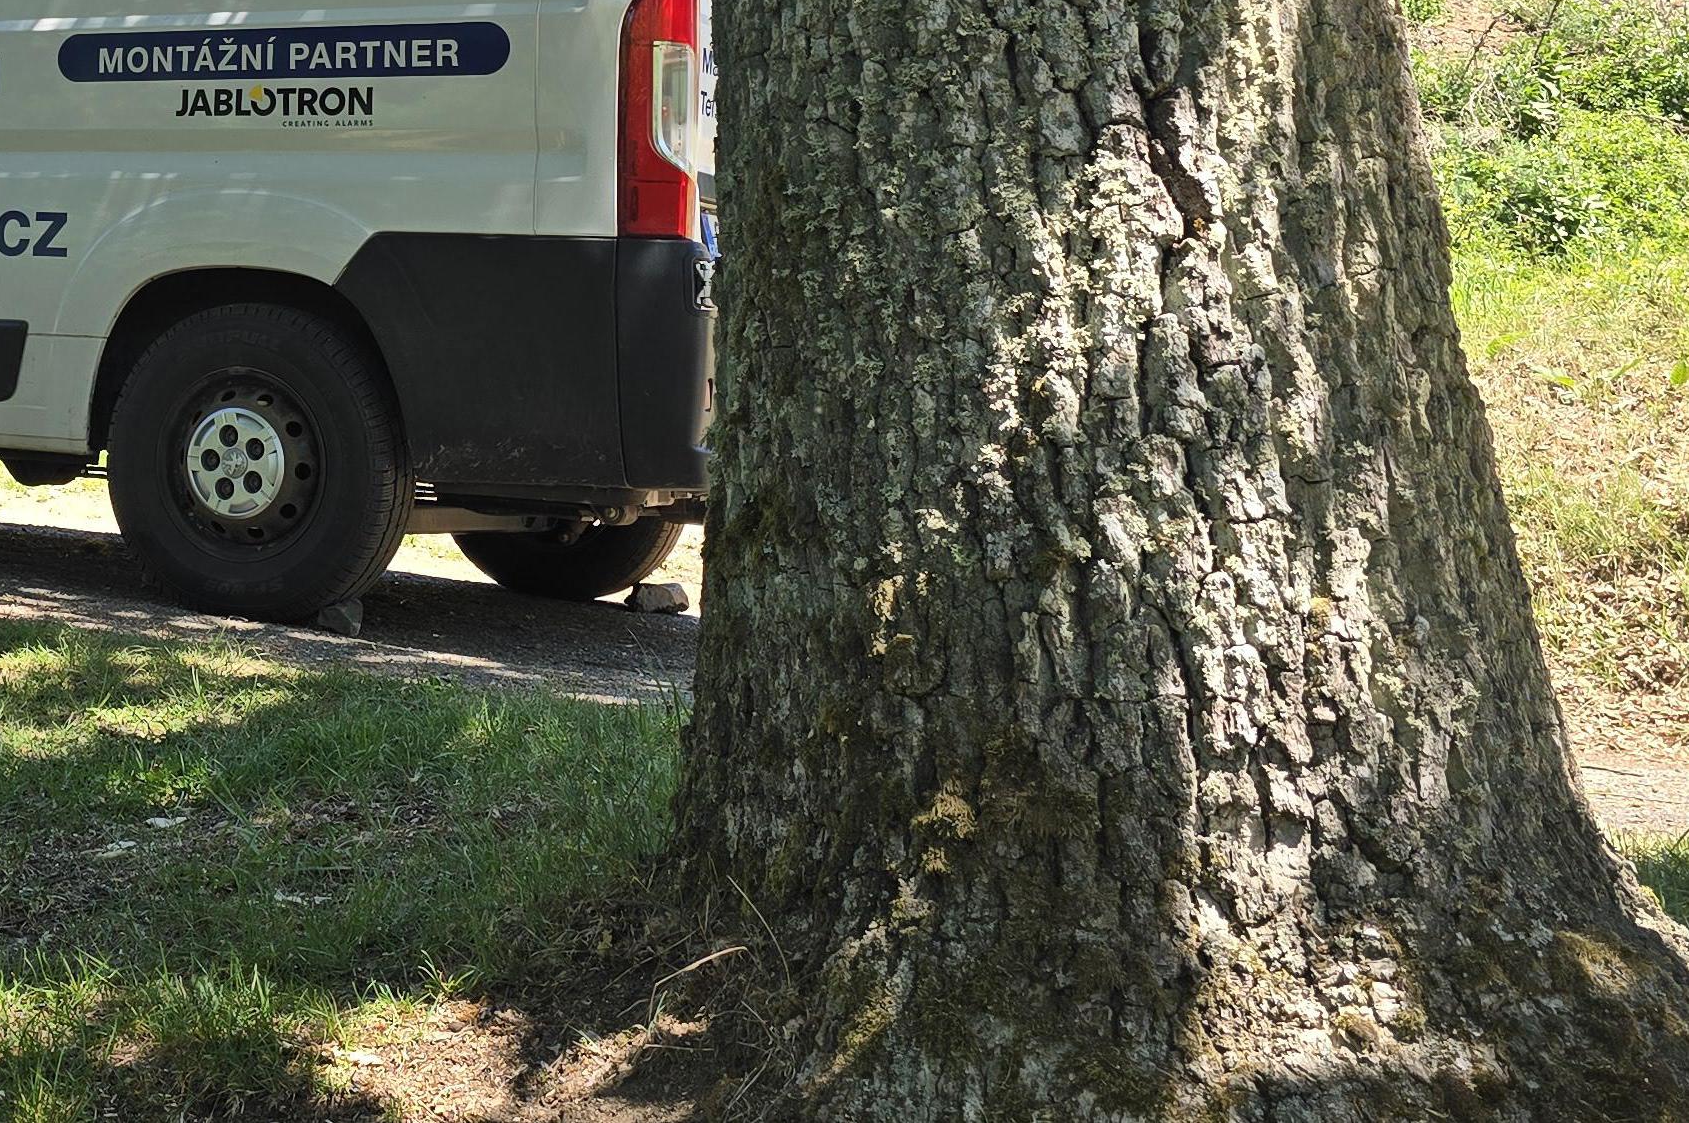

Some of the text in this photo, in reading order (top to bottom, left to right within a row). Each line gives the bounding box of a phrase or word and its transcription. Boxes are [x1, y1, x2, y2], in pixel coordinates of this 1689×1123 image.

[99, 36, 458, 73] MONTÁŽNÍ PARTNER
[176, 87, 373, 116] JABLOTRON
[280, 119, 375, 128] CREATING ALARMS
